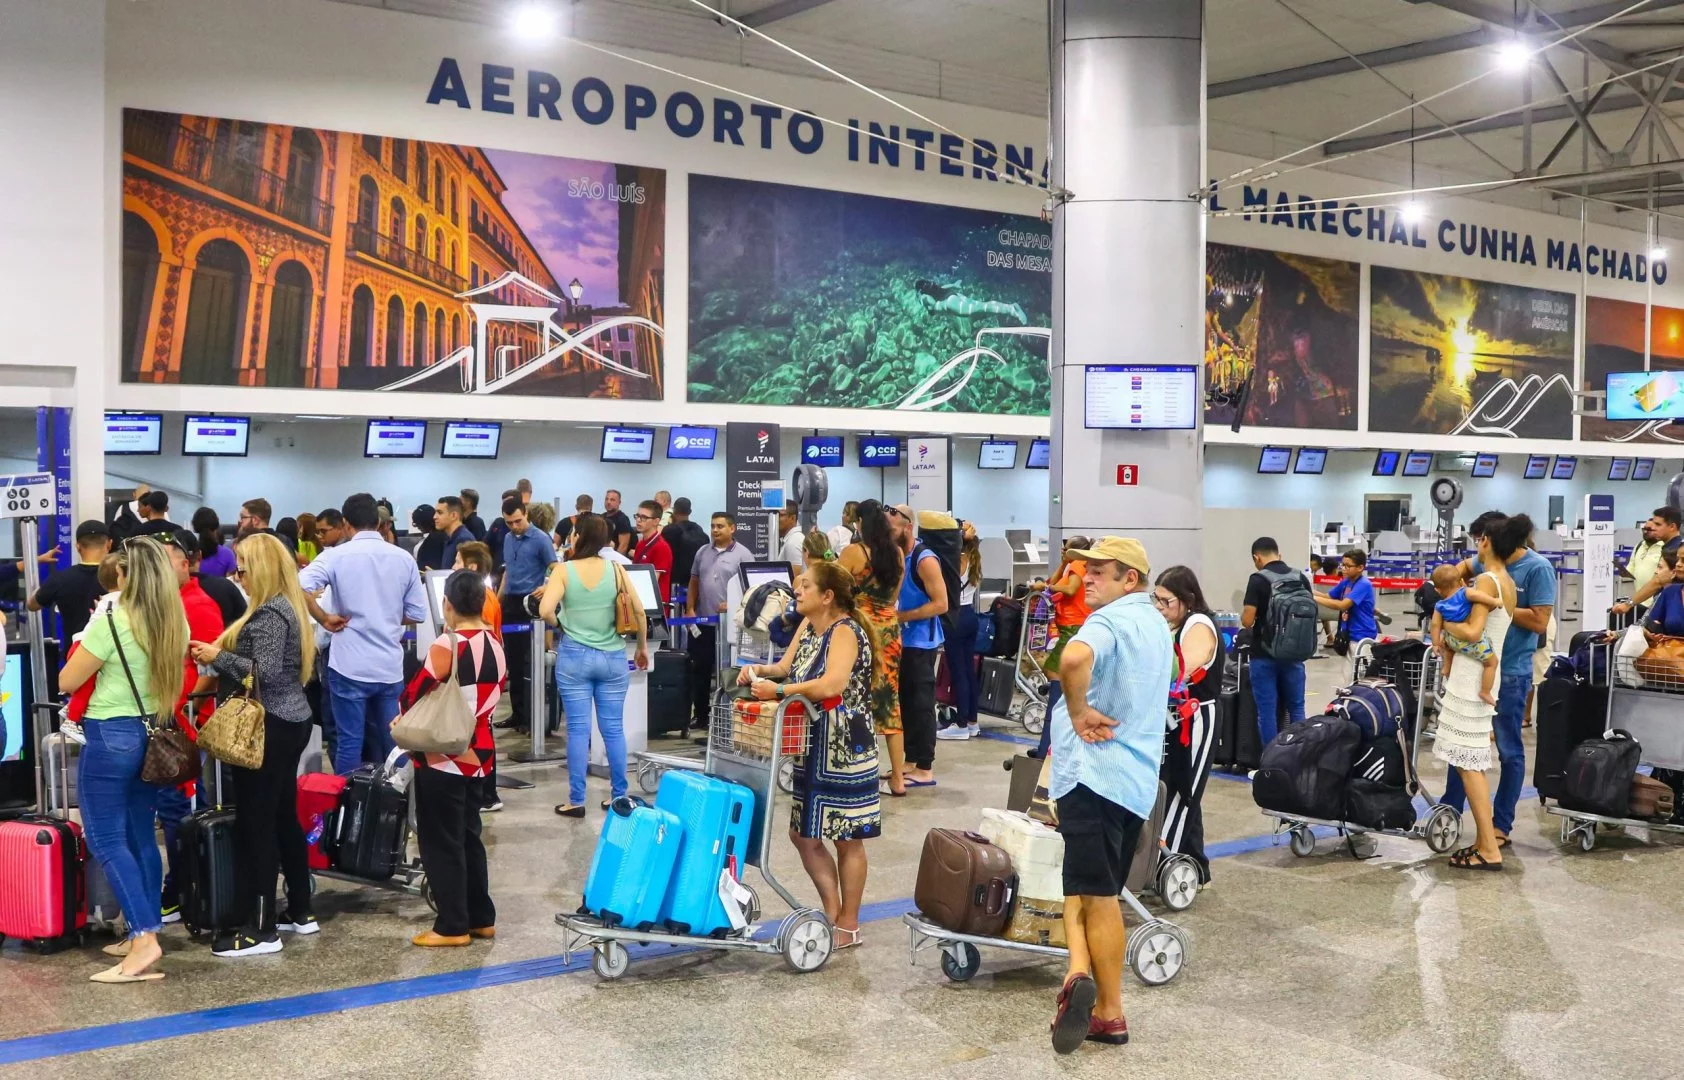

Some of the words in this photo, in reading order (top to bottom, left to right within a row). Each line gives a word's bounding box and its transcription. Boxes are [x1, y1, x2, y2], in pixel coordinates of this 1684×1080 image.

[426, 57, 824, 155] AEROPORTO
[1243, 185, 1427, 249] MARECHAL
[1437, 219, 1537, 267] CUNHA
[1547, 238, 1668, 285] MACHADO
[567, 177, 604, 200] SÃO
[608, 182, 646, 204] LUÍS
[998, 229, 1052, 250] CHAPAD
[987, 250, 1013, 268] DAS
[1015, 253, 1052, 272] MESA
[689, 438, 711, 446] CCR
[820, 446, 840, 454] CCR
[877, 446, 897, 454] CCR
[737, 480, 762, 489] Check-
